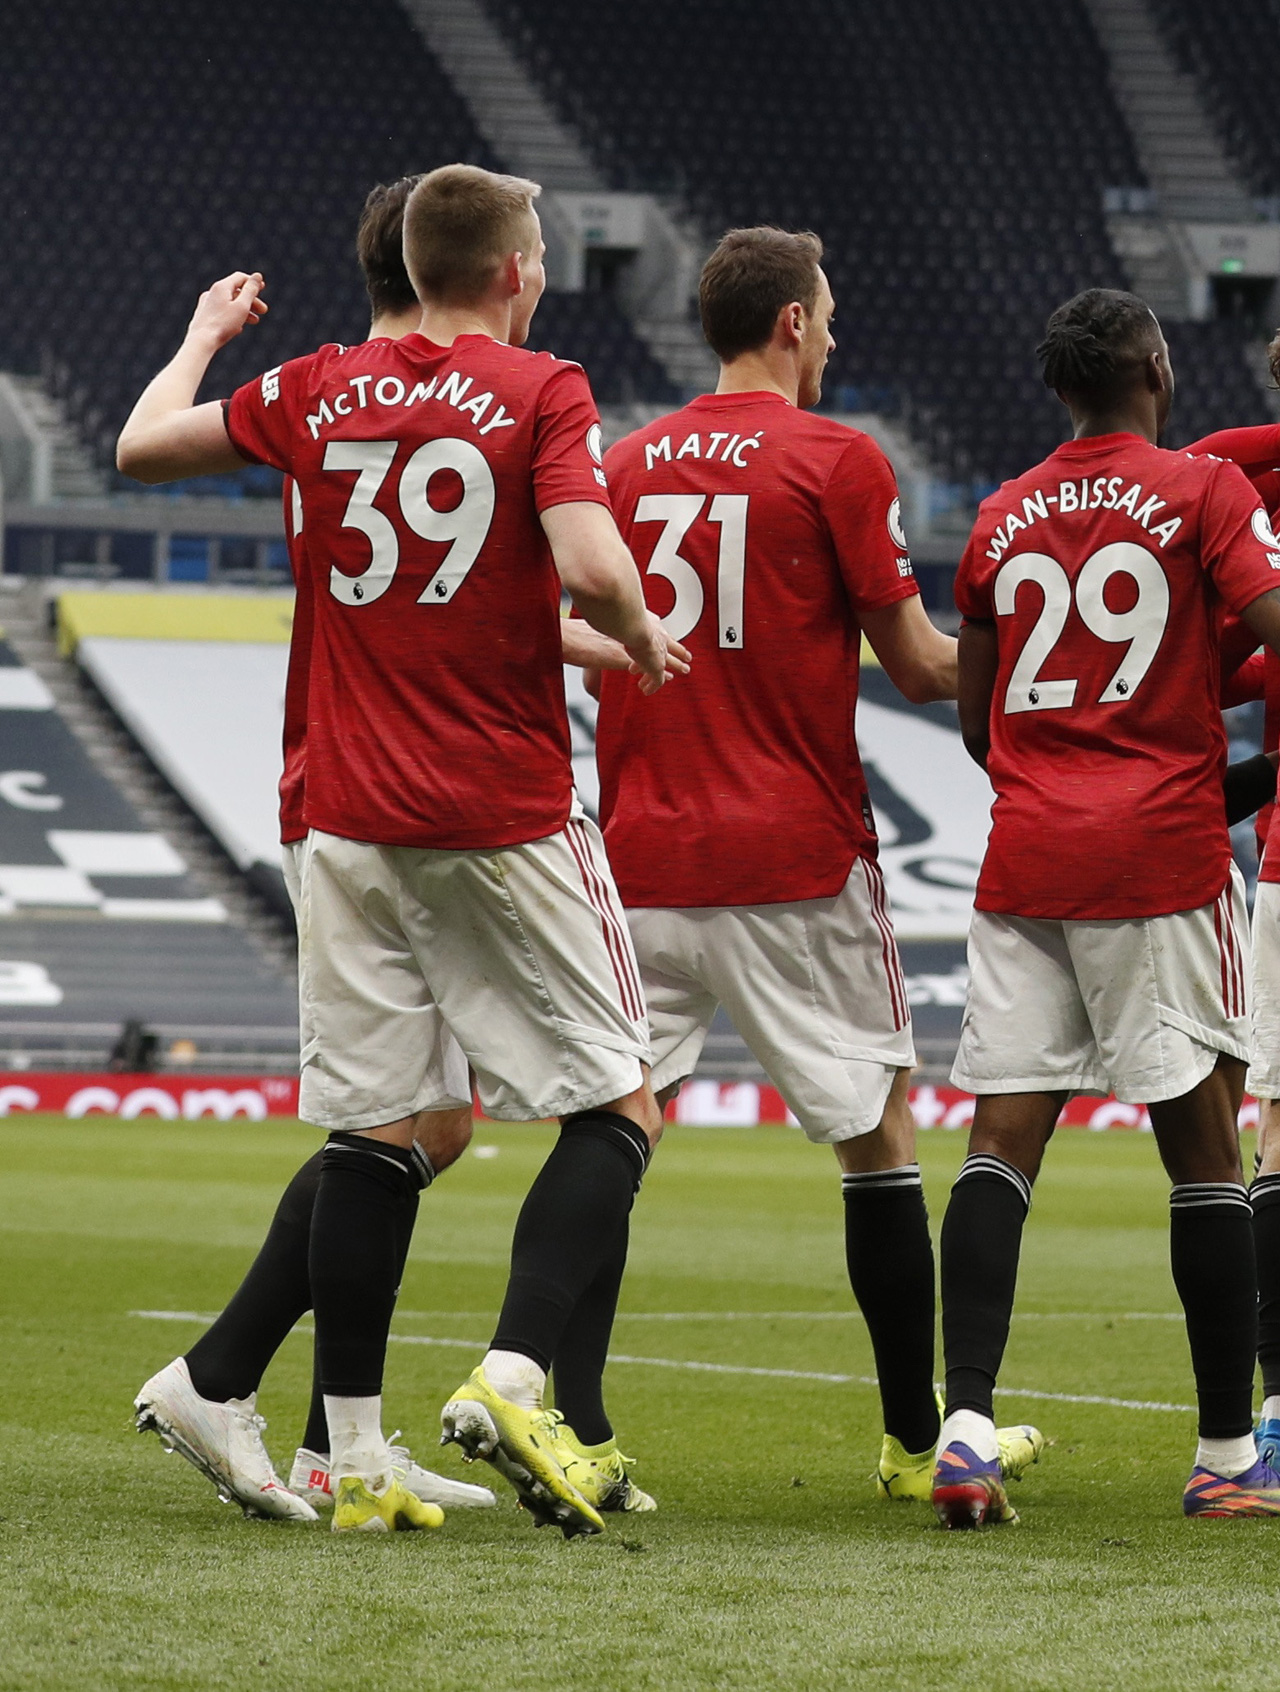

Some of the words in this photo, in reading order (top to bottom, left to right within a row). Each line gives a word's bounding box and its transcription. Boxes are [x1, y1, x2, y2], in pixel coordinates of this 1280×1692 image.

[322, 437, 496, 606] 39
[644, 431, 764, 471] MATIĆ
[985, 476, 1183, 562] WAN-BISSAKA
[633, 493, 749, 649] 31
[994, 541, 1170, 714] 29
